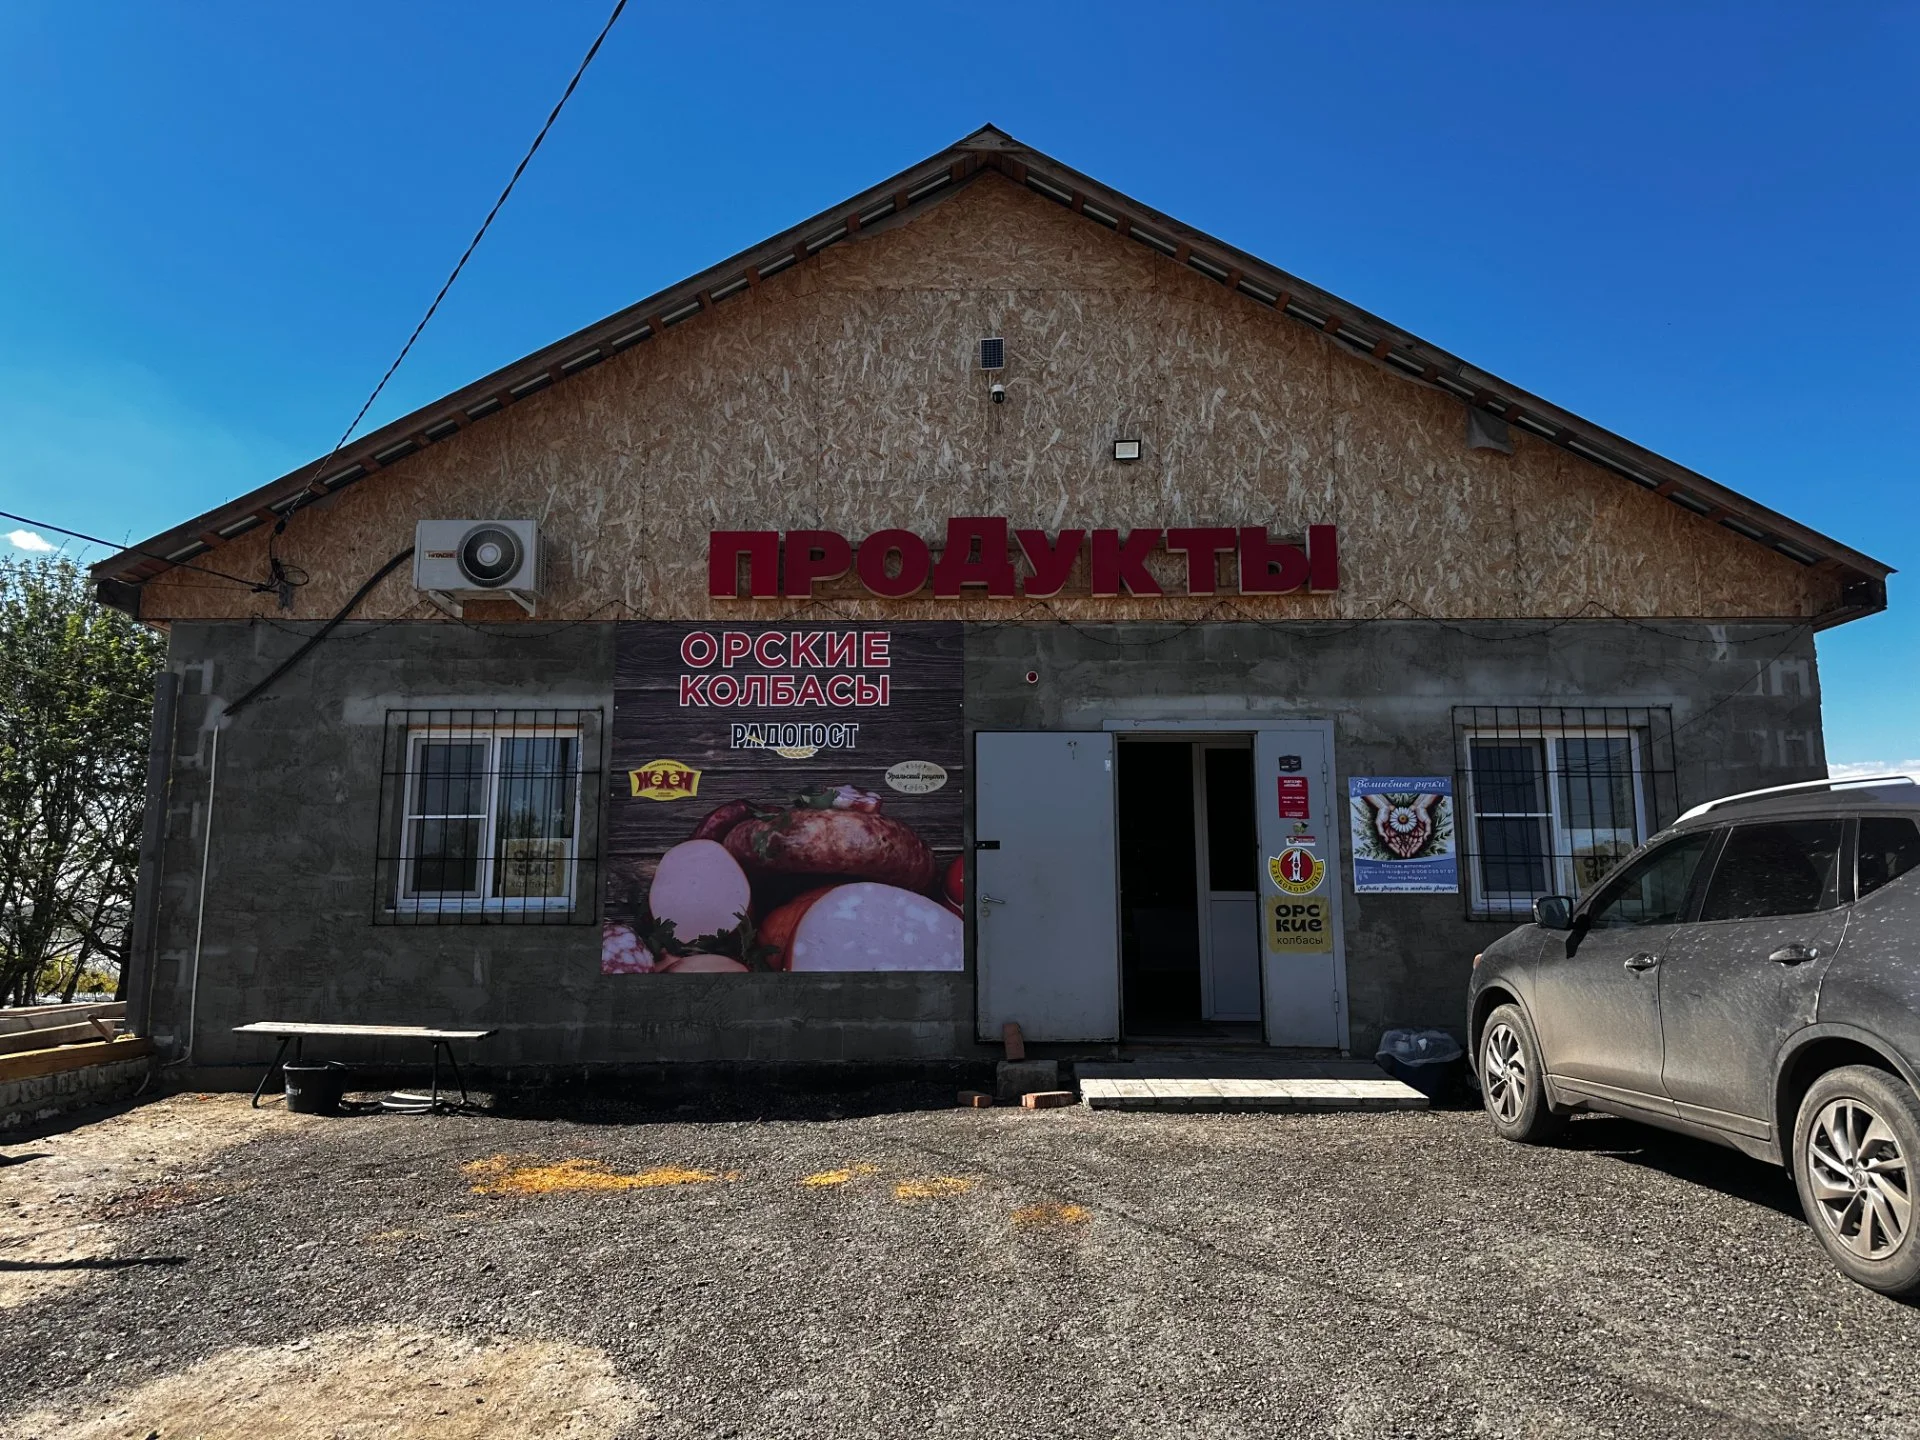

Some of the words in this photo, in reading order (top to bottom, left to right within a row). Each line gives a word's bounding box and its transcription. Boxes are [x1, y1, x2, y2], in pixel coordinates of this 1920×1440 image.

[709, 516, 1339, 600] ПРОДУКТЫ
[680, 631, 891, 669] ОРСКИЕ
[679, 674, 890, 707] КОЛБАСЫ
[730, 723, 859, 749] РАДОГОСТ
[1356, 779, 1410, 789] Волшебные
[1414, 780, 1445, 790] ручки
[1277, 935, 1323, 945] колбасы
